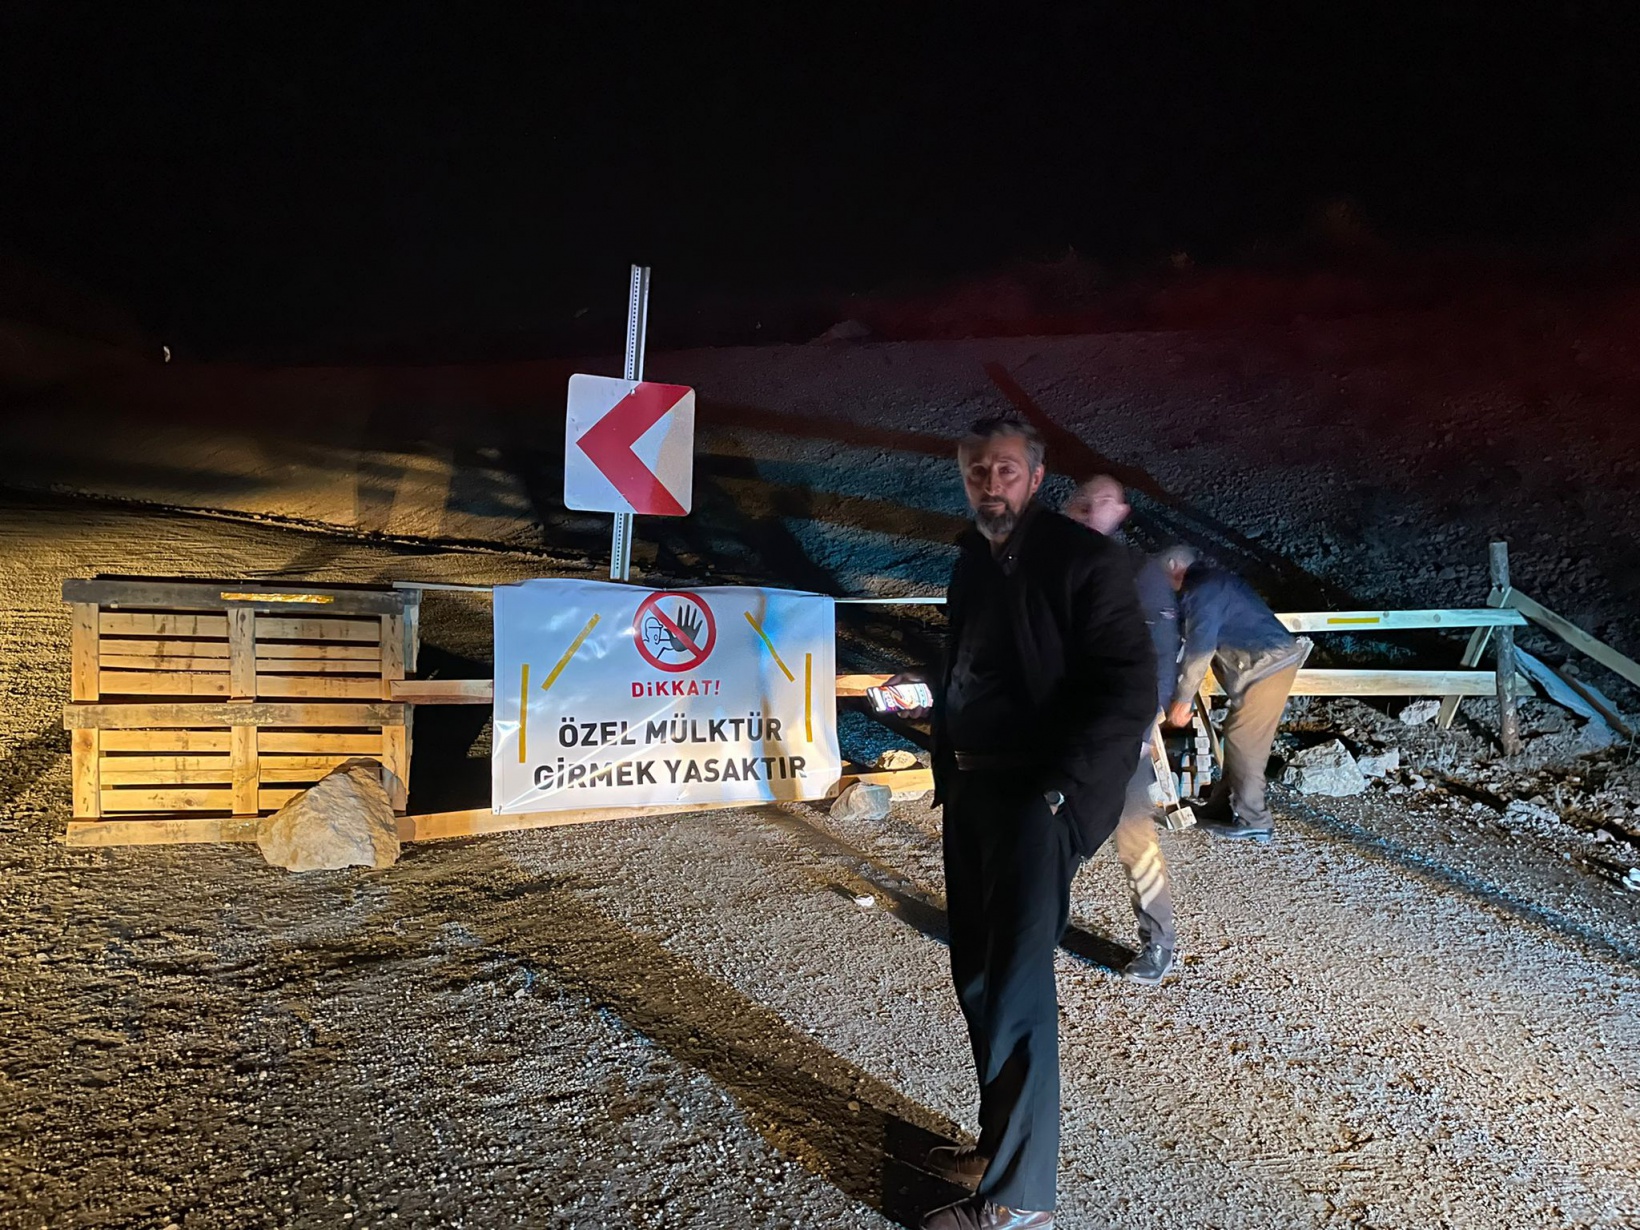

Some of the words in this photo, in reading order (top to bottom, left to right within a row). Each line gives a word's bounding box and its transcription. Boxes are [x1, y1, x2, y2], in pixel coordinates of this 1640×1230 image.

[558, 716, 637, 748] ÖZEL
[645, 712, 783, 744] MÜLKTÜR
[534, 756, 658, 791] GİRMEK
[663, 755, 808, 783] YASAKTIR
